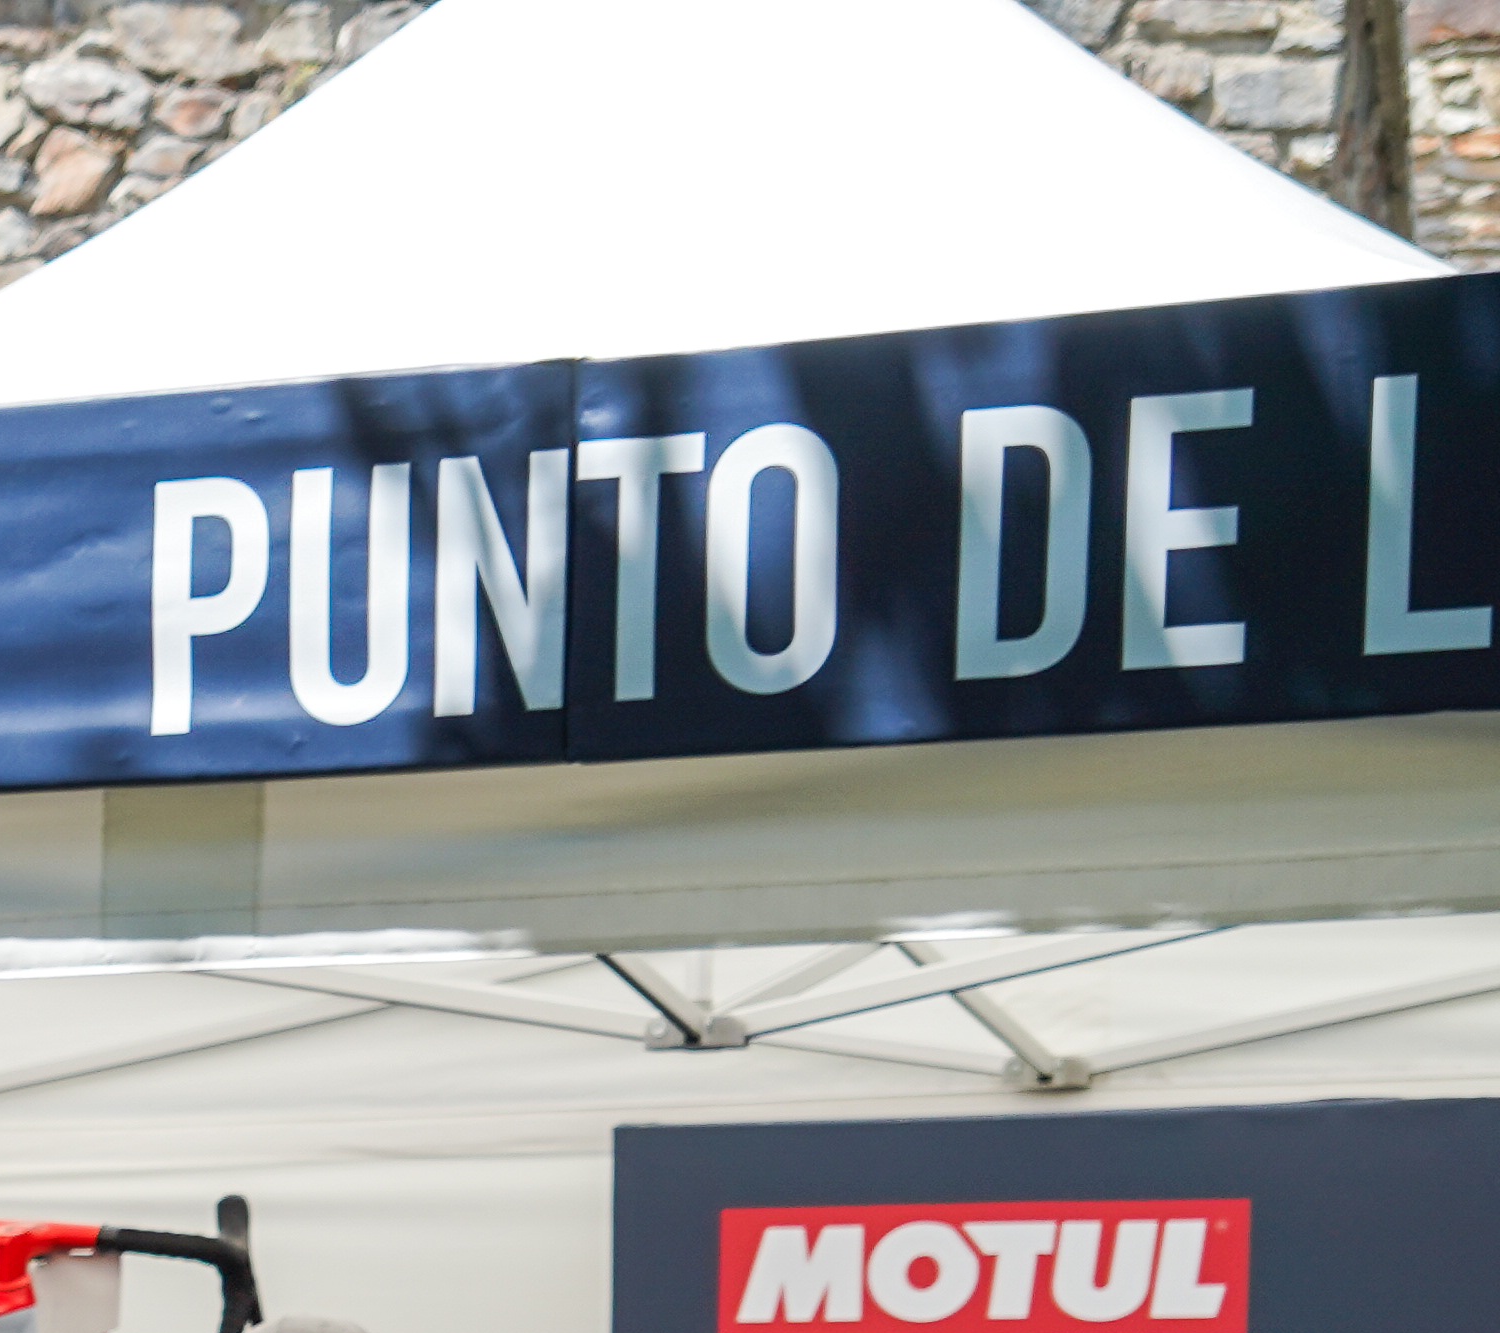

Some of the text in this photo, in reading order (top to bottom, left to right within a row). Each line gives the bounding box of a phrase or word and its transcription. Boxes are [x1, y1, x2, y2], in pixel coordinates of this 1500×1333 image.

[150, 422, 838, 737] PUNTO
[955, 387, 1254, 681] DE
[735, 1218, 1228, 1323] MOTUL
